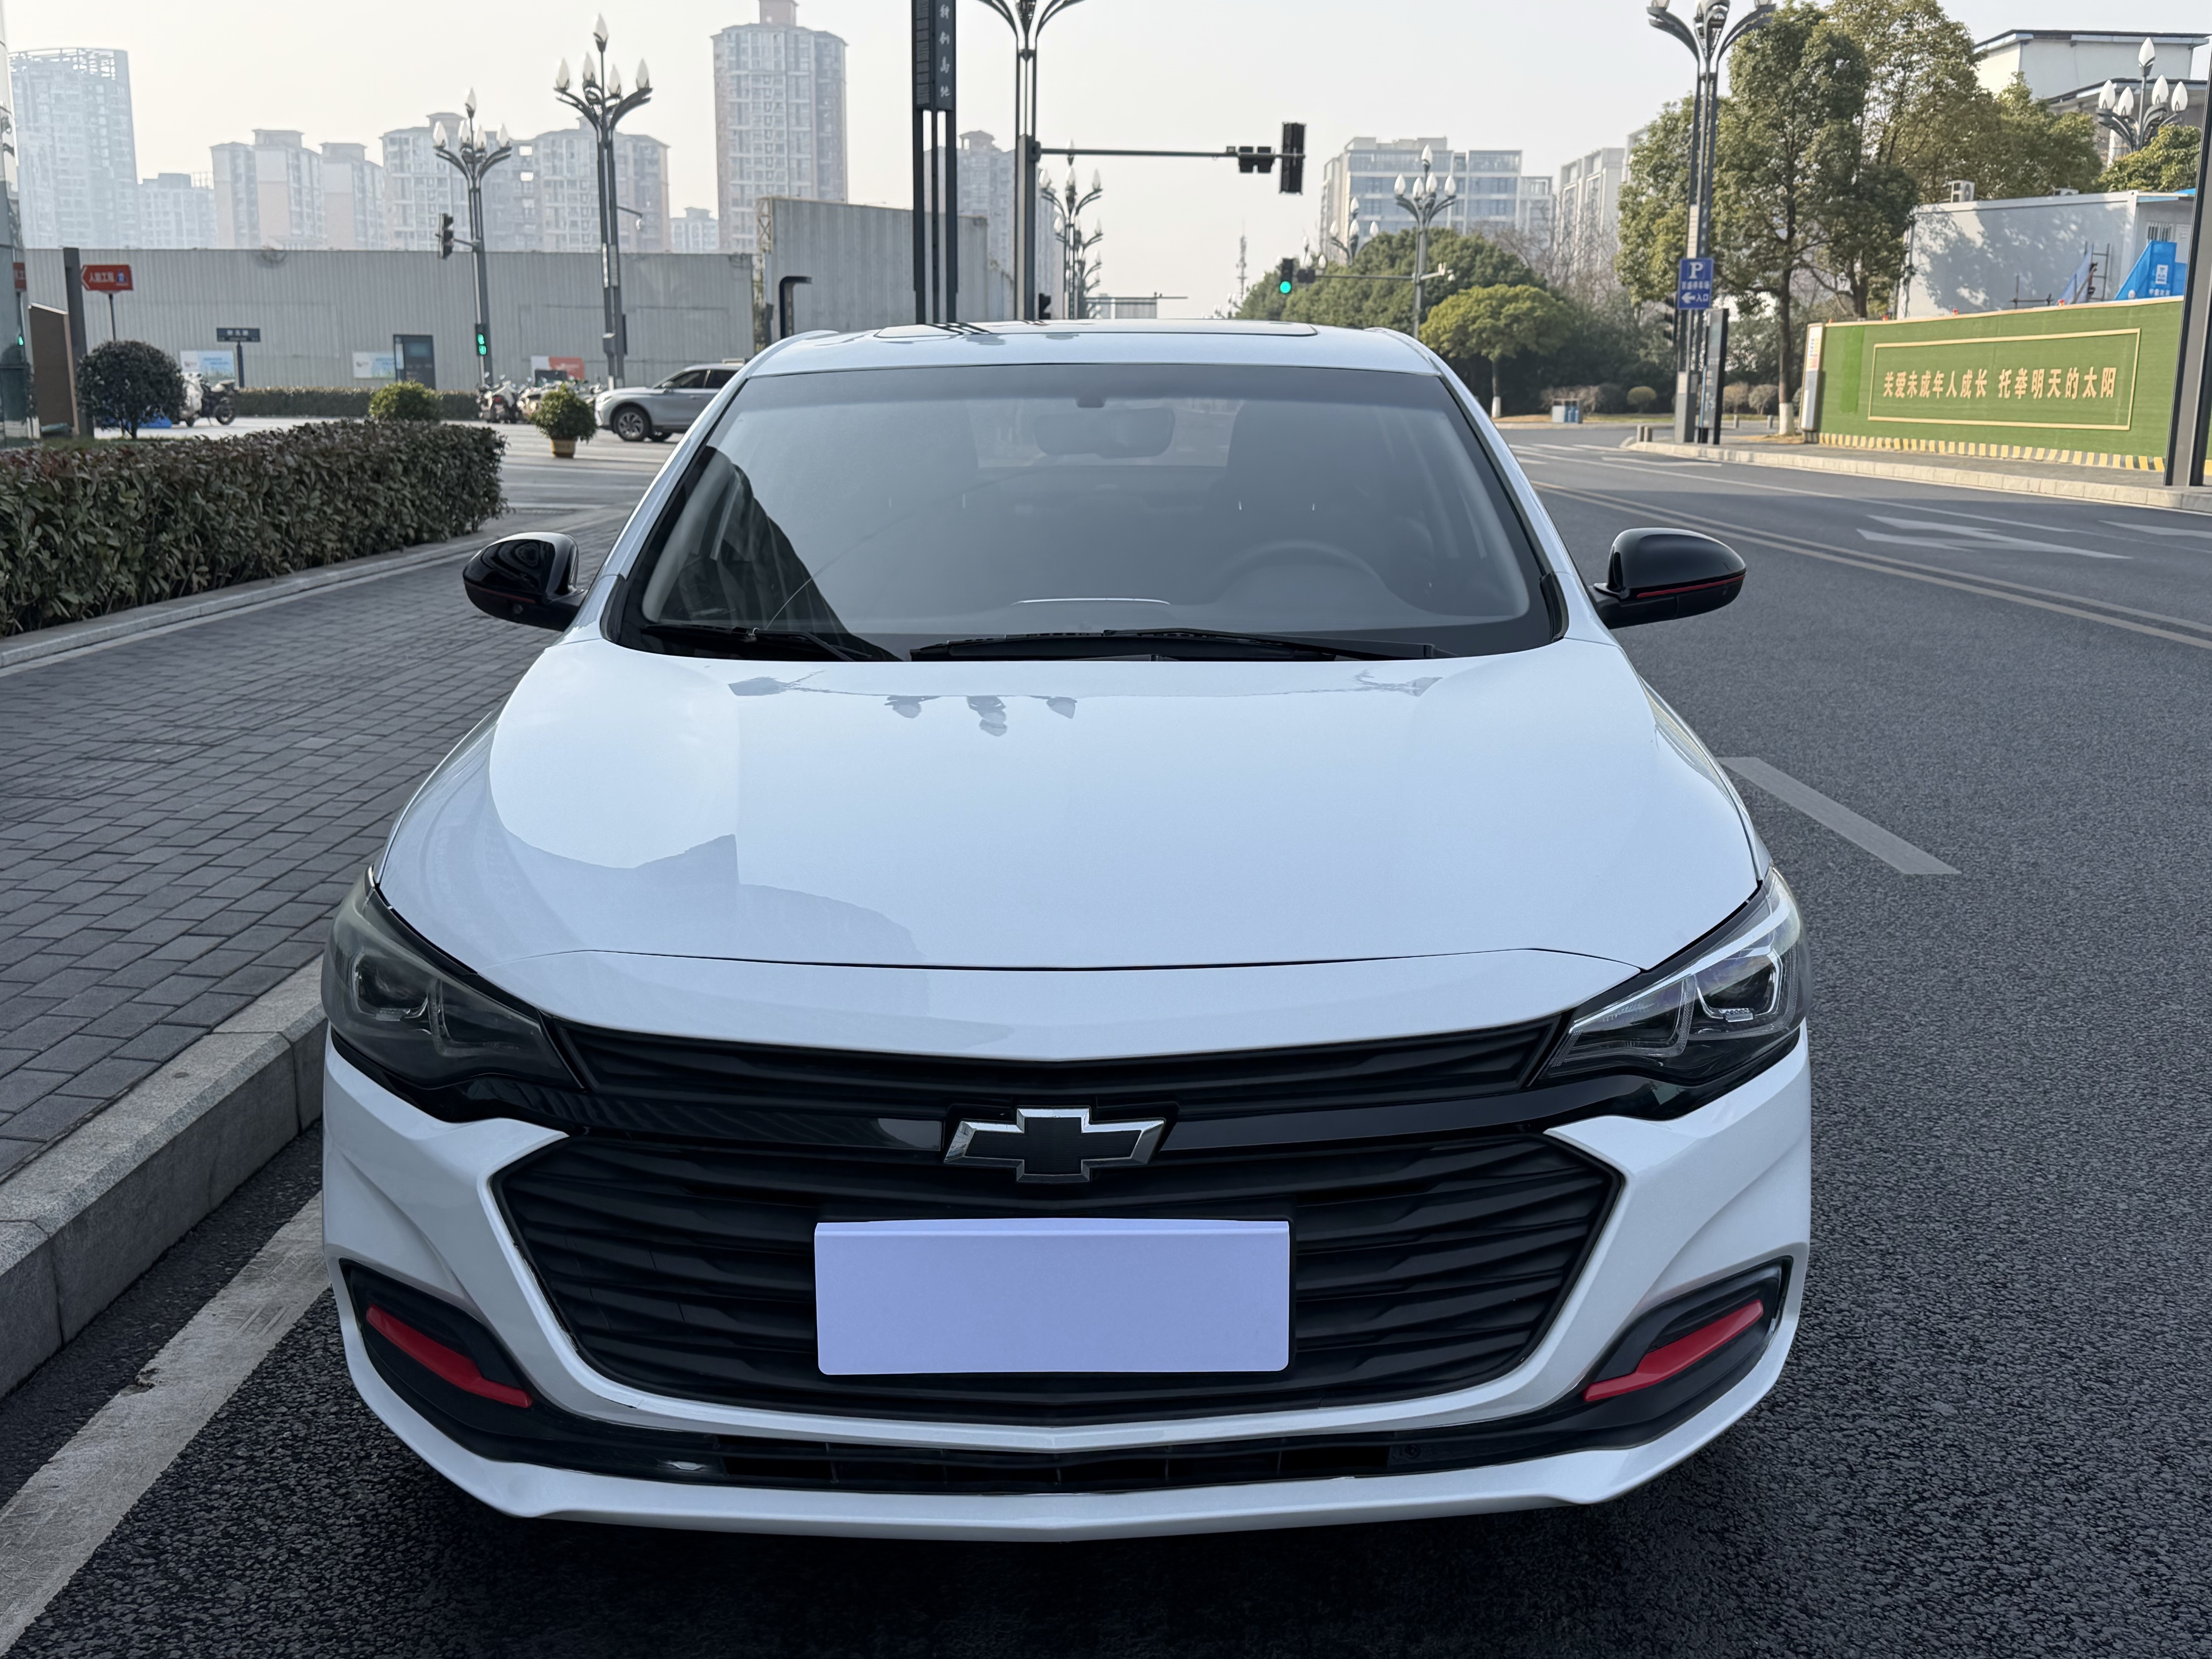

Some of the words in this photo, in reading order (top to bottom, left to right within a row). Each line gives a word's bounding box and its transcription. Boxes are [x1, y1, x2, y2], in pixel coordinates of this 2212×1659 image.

[1689, 262, 1704, 279] P
[1883, 368, 1988, 399] 关爱未成年人成长
[1998, 366, 2117, 400] 托举明天的太阳
